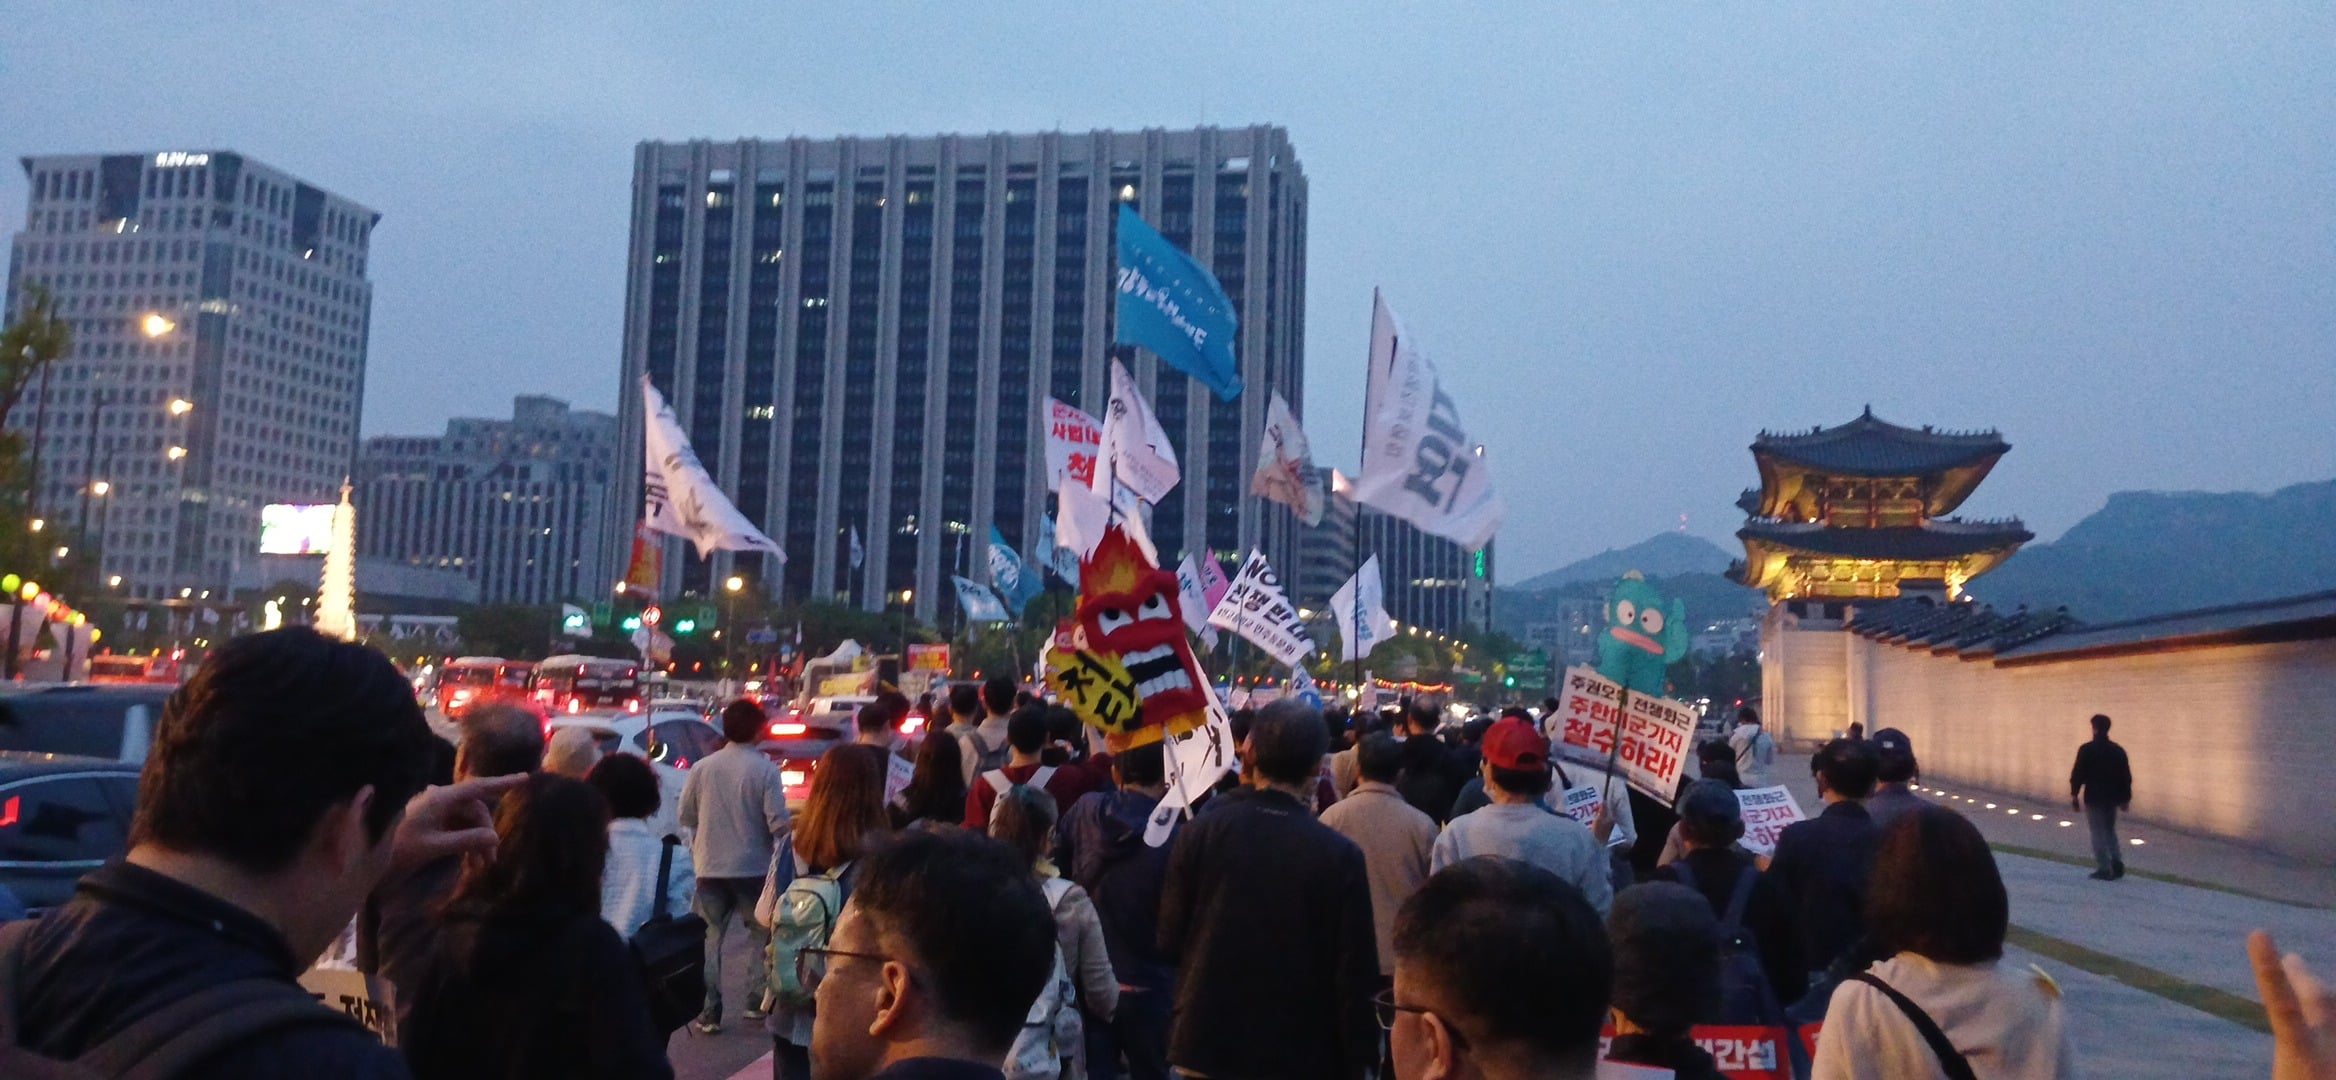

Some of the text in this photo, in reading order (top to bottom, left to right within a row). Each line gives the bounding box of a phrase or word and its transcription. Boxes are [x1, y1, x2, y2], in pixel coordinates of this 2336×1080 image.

[1569, 695, 1683, 754] 주한미군기지
[1633, 697, 1691, 731] 전쟁화근
[1563, 718, 1677, 784] 철수하라!
